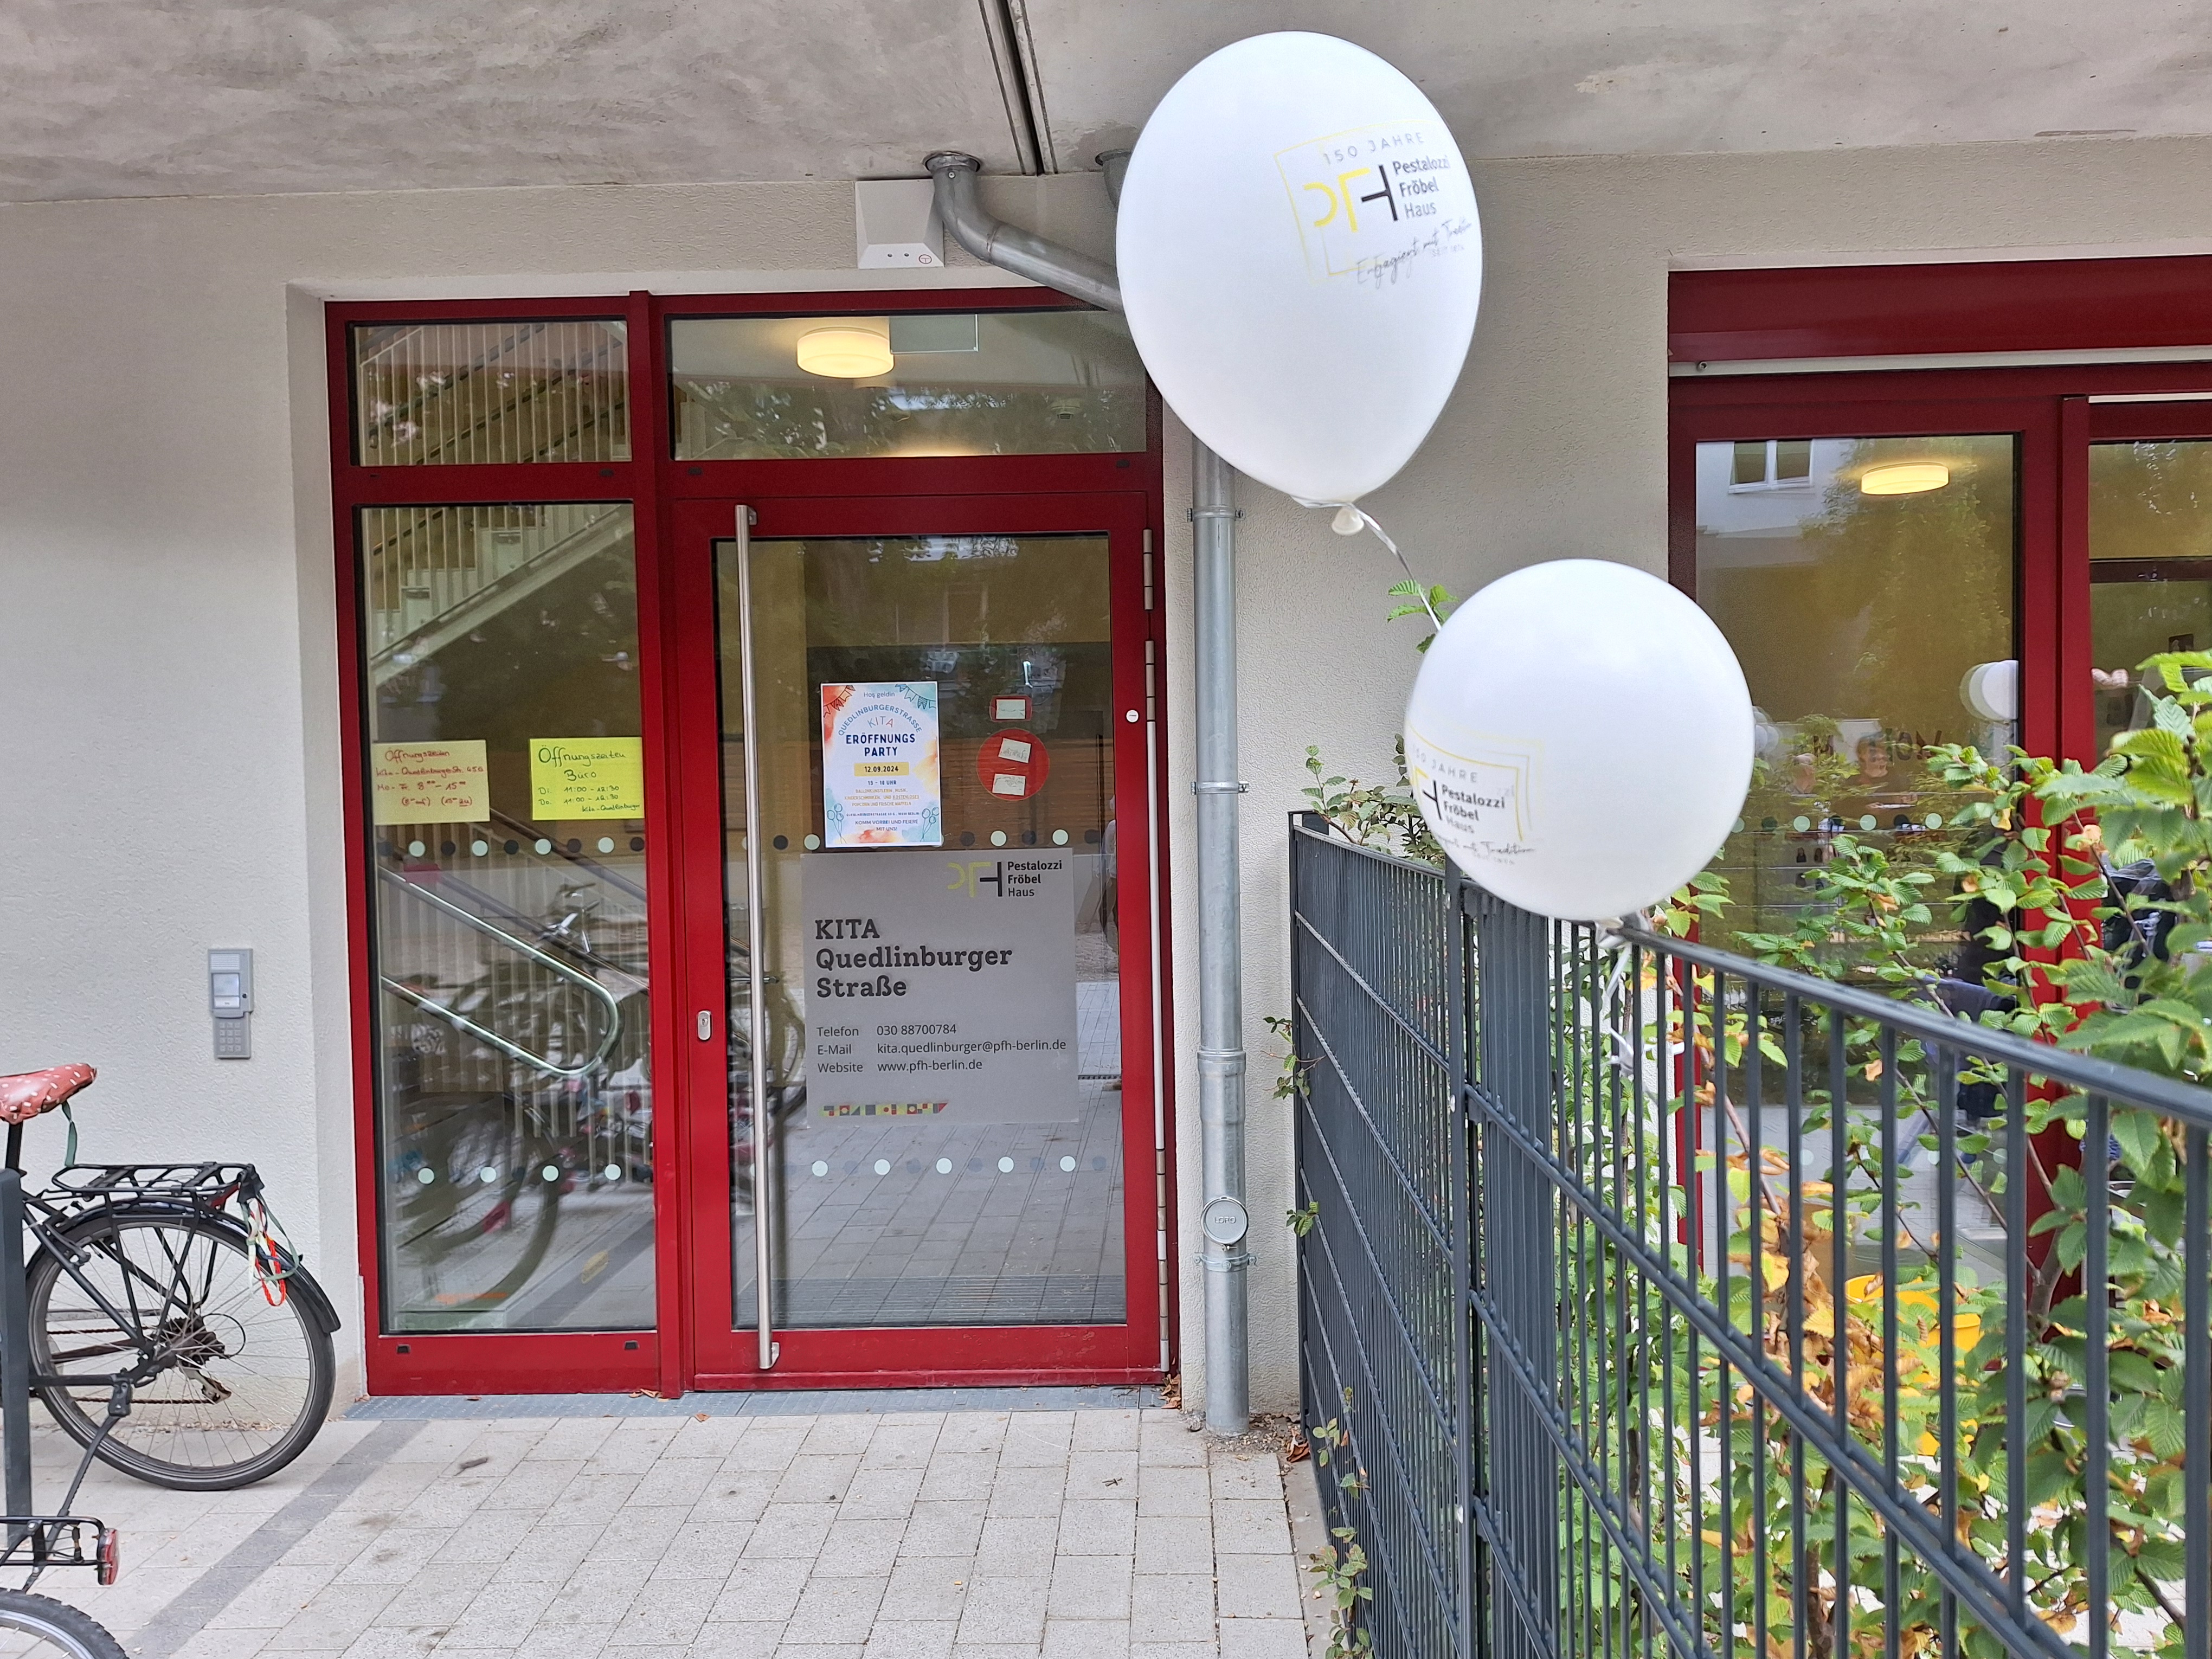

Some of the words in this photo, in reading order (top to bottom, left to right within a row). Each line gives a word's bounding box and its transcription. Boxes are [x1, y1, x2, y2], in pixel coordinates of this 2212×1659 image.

[1323, 145, 1357, 165] 150
[1368, 132, 1425, 152] JAHRE
[1392, 155, 1451, 175] Pestalozzi
[1399, 177, 1440, 197] Fröbel
[1404, 202, 1437, 219] Haus
[838, 704, 922, 736] QUEDLINBURGERSTRASSE
[867, 716, 893, 728] KITA
[846, 732, 915, 744] ERÖFFNUNGS
[538, 744, 626, 767] Öffnungszeiten
[864, 747, 897, 756] PARTY
[564, 769, 596, 781] Büro
[1432, 759, 1477, 782] JAHRE
[1442, 784, 1506, 809] Pestalozzi
[1443, 801, 1480, 821] Fröbel
[1445, 815, 1474, 834] Haus
[1007, 860, 1063, 871] Pestalozzi
[1007, 874, 1041, 884] Fröbel
[1008, 888, 1035, 897] Haus
[815, 918, 880, 940] KITA
[816, 946, 1013, 972] Quedlinburger
[816, 975, 907, 998] Straße
[817, 1026, 859, 1037] Telefon
[877, 1025, 898, 1036] 030
[901, 1024, 957, 1036] 88700784
[818, 1044, 852, 1055] E-Mail
[877, 1039, 1066, 1056] kita.quedlinburger@pfh-berlin.de
[818, 1062, 864, 1073] Website
[877, 1060, 983, 1075] www.pfh-berlin.de
